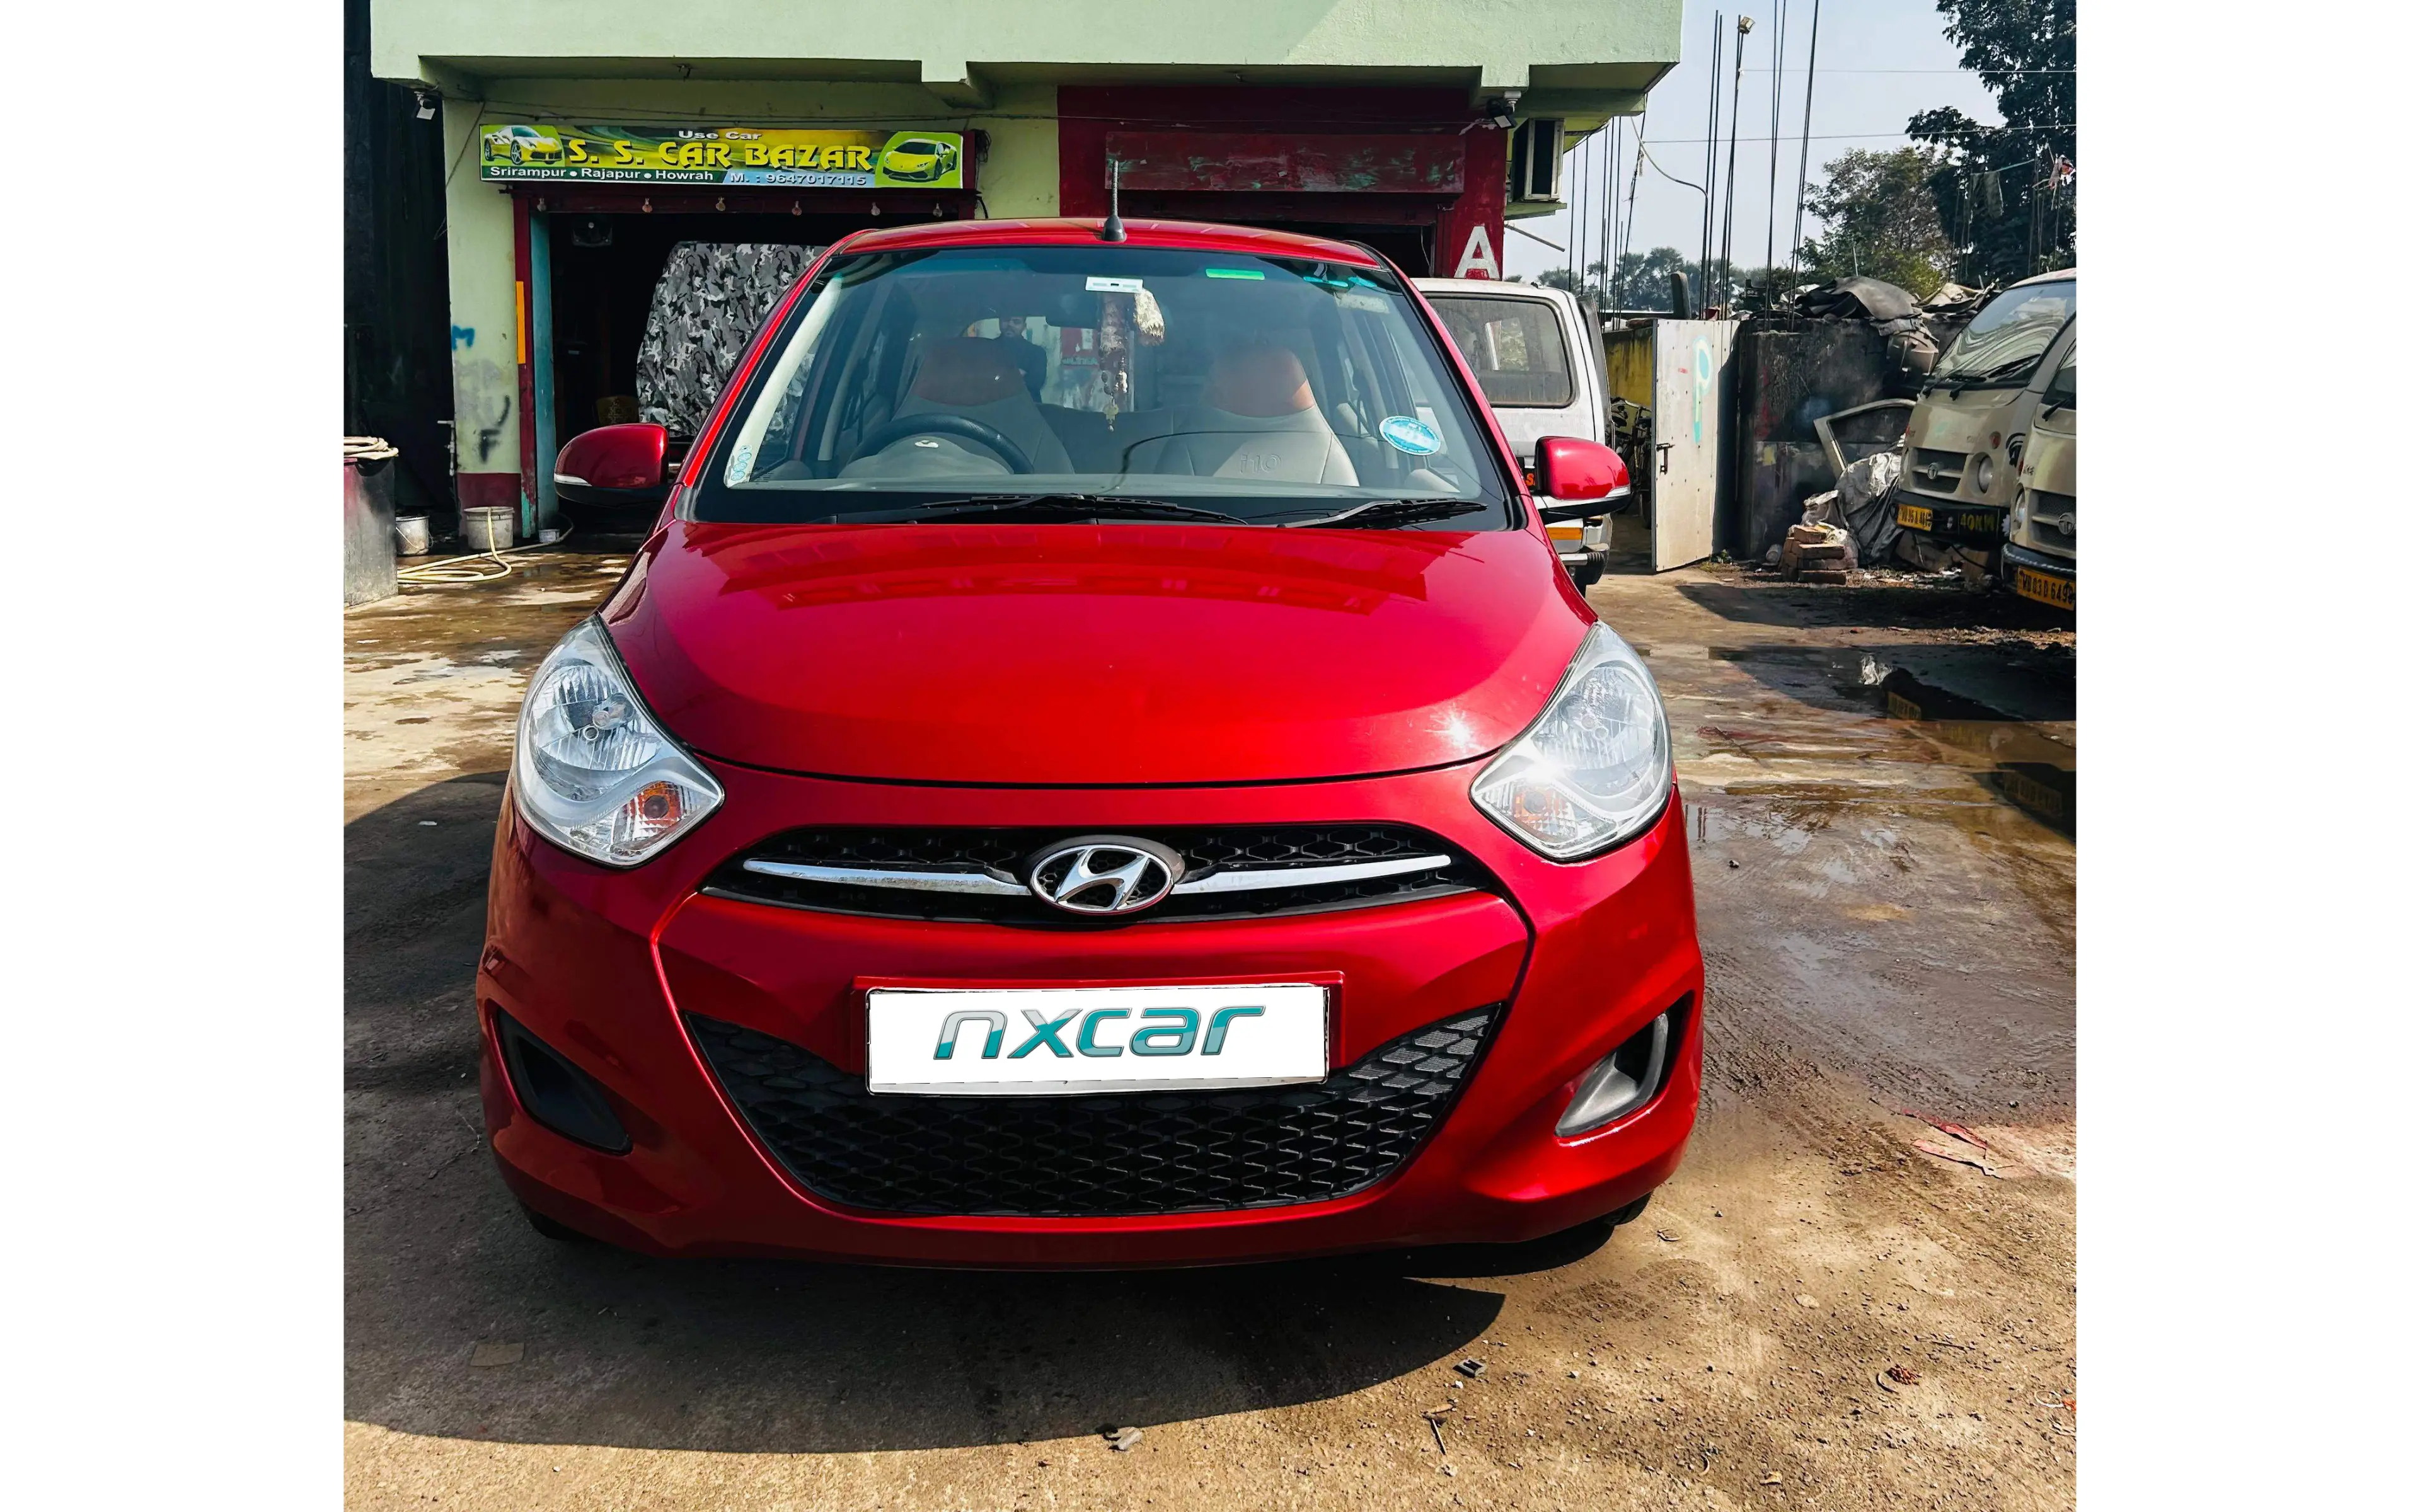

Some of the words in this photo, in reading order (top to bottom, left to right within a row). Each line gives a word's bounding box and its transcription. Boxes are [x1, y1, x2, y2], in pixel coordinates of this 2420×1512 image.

[679, 130, 718, 139] Use
[725, 132, 762, 140] Car
[568, 139, 599, 164] S.
[614, 140, 644, 166] S.
[659, 141, 734, 169] CAR
[744, 143, 874, 171] BAZAR
[490, 166, 567, 178] Srirampur
[581, 168, 641, 180] Rajapur
[655, 170, 713, 180] Howrah
[766, 173, 867, 185] 9647017115
[1453, 226, 1501, 279] A
